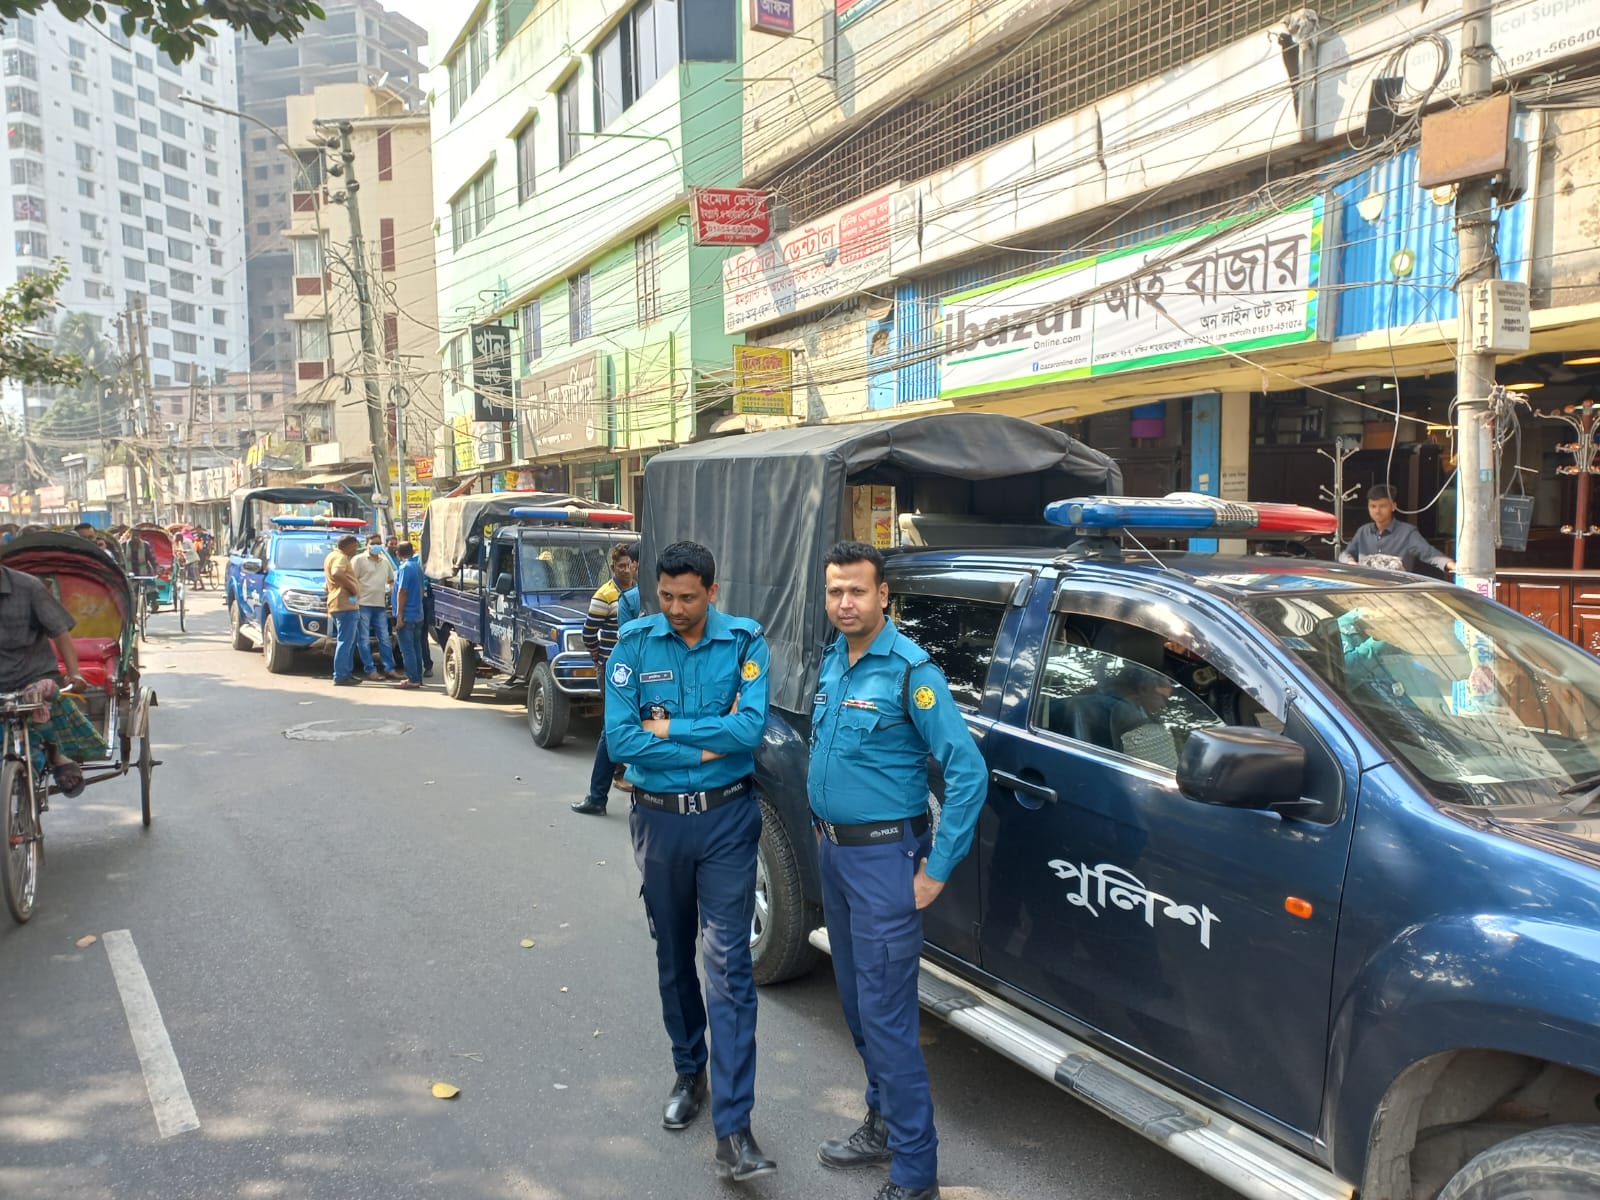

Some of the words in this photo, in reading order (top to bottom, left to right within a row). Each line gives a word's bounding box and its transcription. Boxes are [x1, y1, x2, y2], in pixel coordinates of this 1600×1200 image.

[784, 224, 836, 262] ডেন্টাল
[1100, 254, 1169, 321] আই
[1186, 233, 1309, 304] বাজার
[944, 298, 1086, 356] ibazar
[1199, 314, 1219, 330] অন
[1221, 306, 1252, 327] লাইন
[1253, 301, 1273, 319] ডট
[1275, 299, 1297, 316] কম
[1033, 334, 1081, 350] Online.com
[881, 826, 899, 836] POLICE
[1047, 858, 1222, 950] পুলিশ
